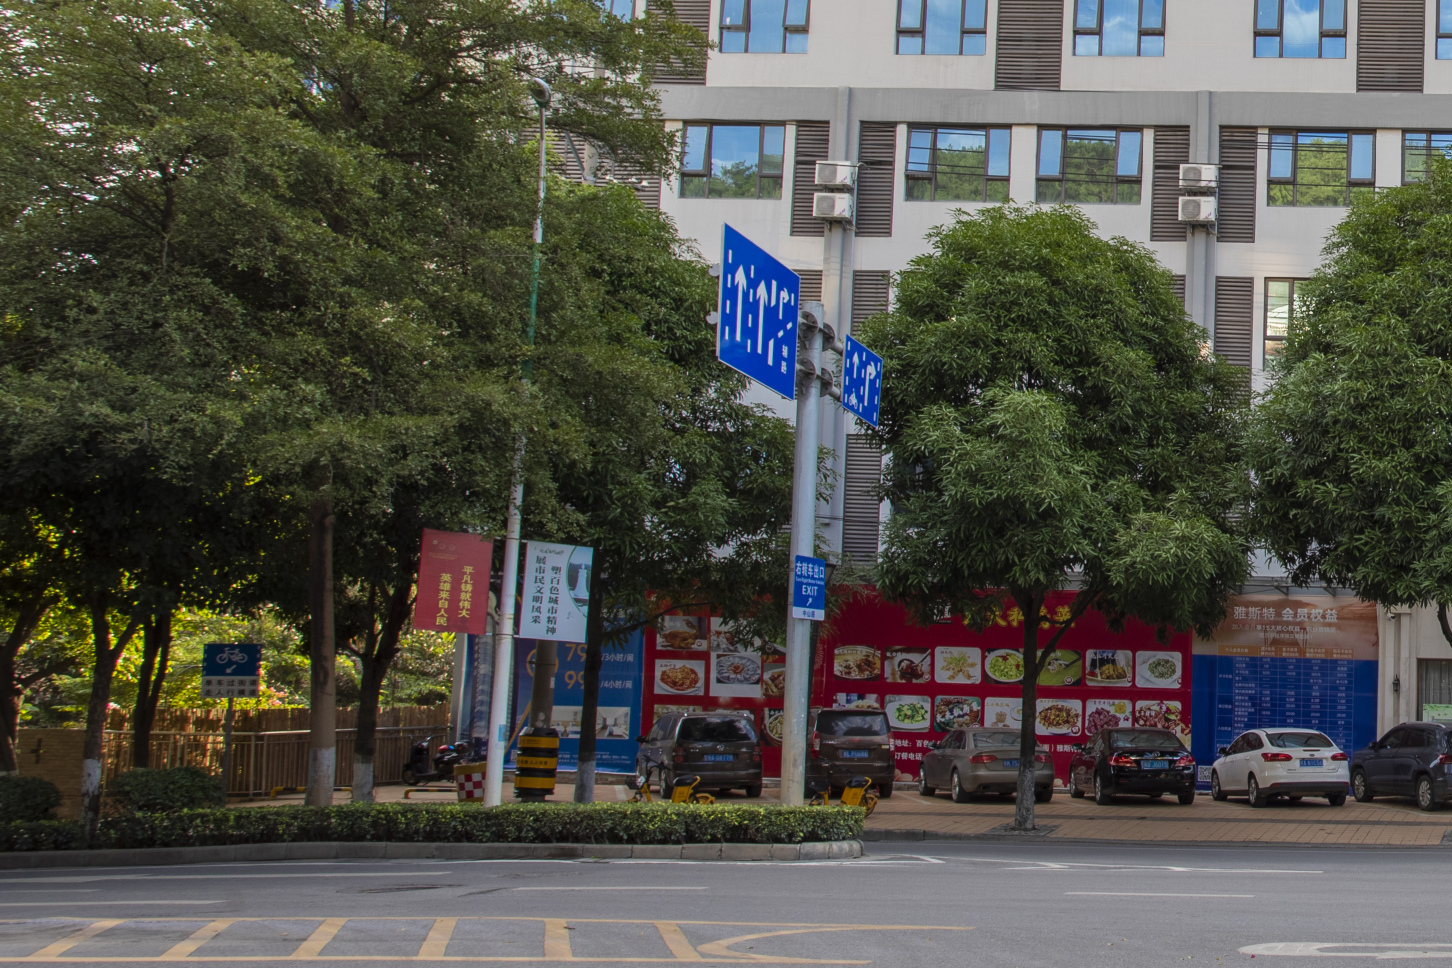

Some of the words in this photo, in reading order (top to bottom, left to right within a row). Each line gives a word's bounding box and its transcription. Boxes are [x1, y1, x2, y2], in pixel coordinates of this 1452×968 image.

[795, 561, 825, 579] 右转车出口
[435, 573, 452, 627] 英雄来自人民
[458, 565, 474, 618] 平凡铸就伟大
[530, 555, 547, 624] 展市民文明风采
[545, 565, 562, 636] 塑百色城市精神
[802, 585, 818, 596] EXIT
[1233, 606, 1276, 621] 雅斯特
[1281, 608, 1338, 623] 会员权益
[895, 752, 923, 761] 订餐电话
